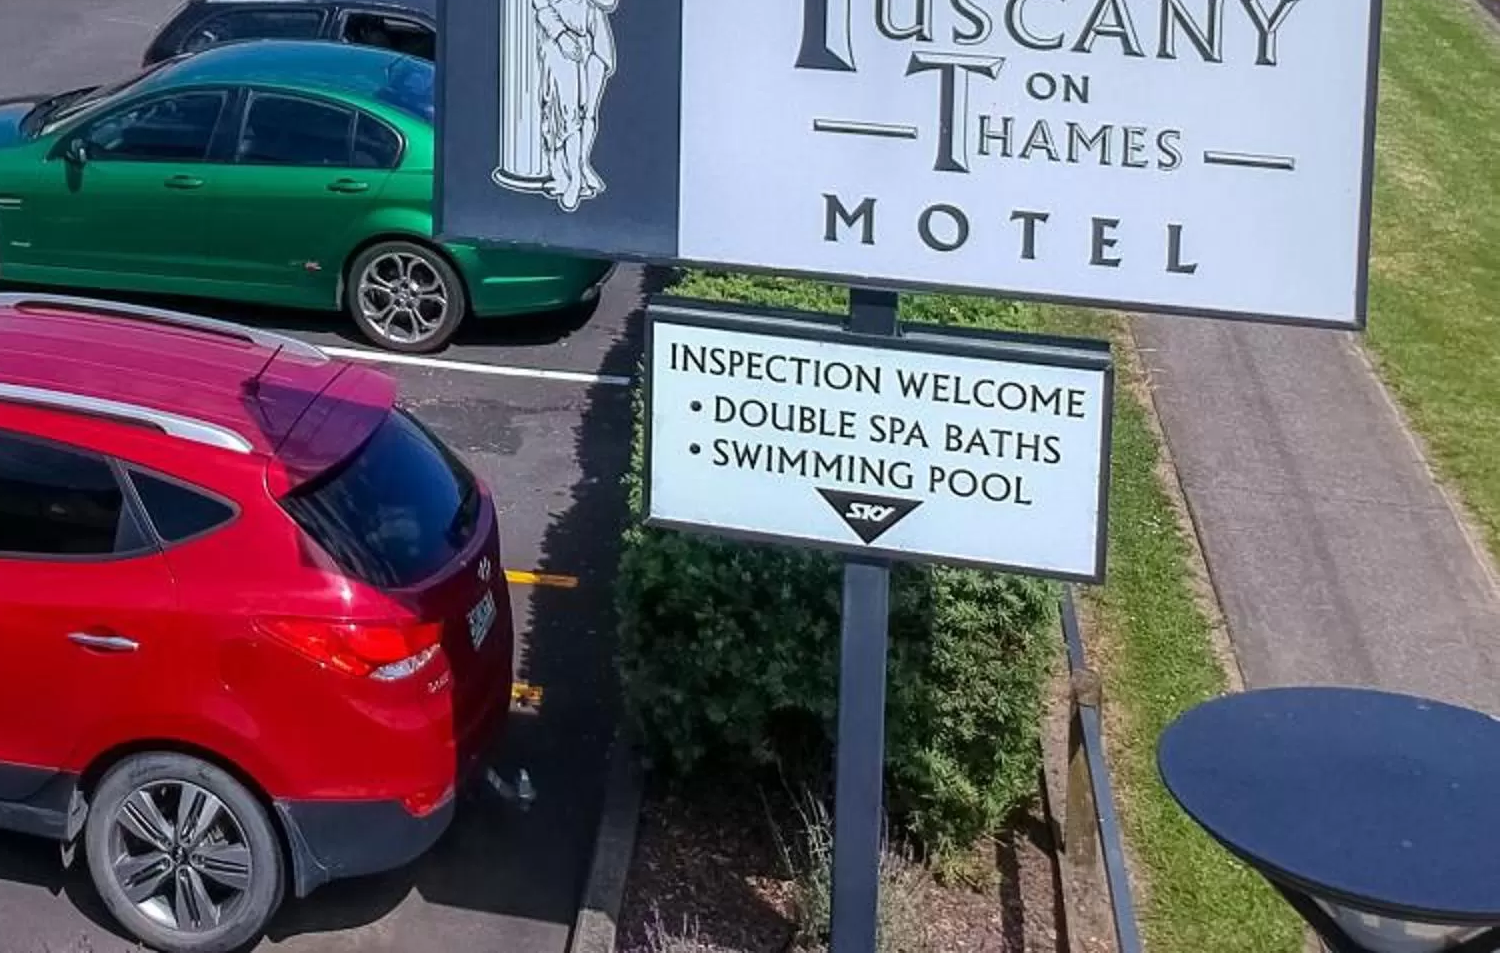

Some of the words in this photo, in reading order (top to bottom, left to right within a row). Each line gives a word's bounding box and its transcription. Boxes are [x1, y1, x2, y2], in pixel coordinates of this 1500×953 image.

[904, 51, 1183, 173] THAMES
[1026, 71, 1090, 104] ON
[821, 193, 1198, 275] MOTEL
[669, 343, 881, 395] INSPECTION
[897, 369, 1086, 419] WELCOME
[713, 395, 856, 440] DOUBLE
[869, 414, 929, 448] SPA
[944, 423, 1061, 465] BATHS
[712, 438, 914, 490] SWIMMING
[928, 466, 1033, 505] POOL
[845, 502, 897, 522] SKY
